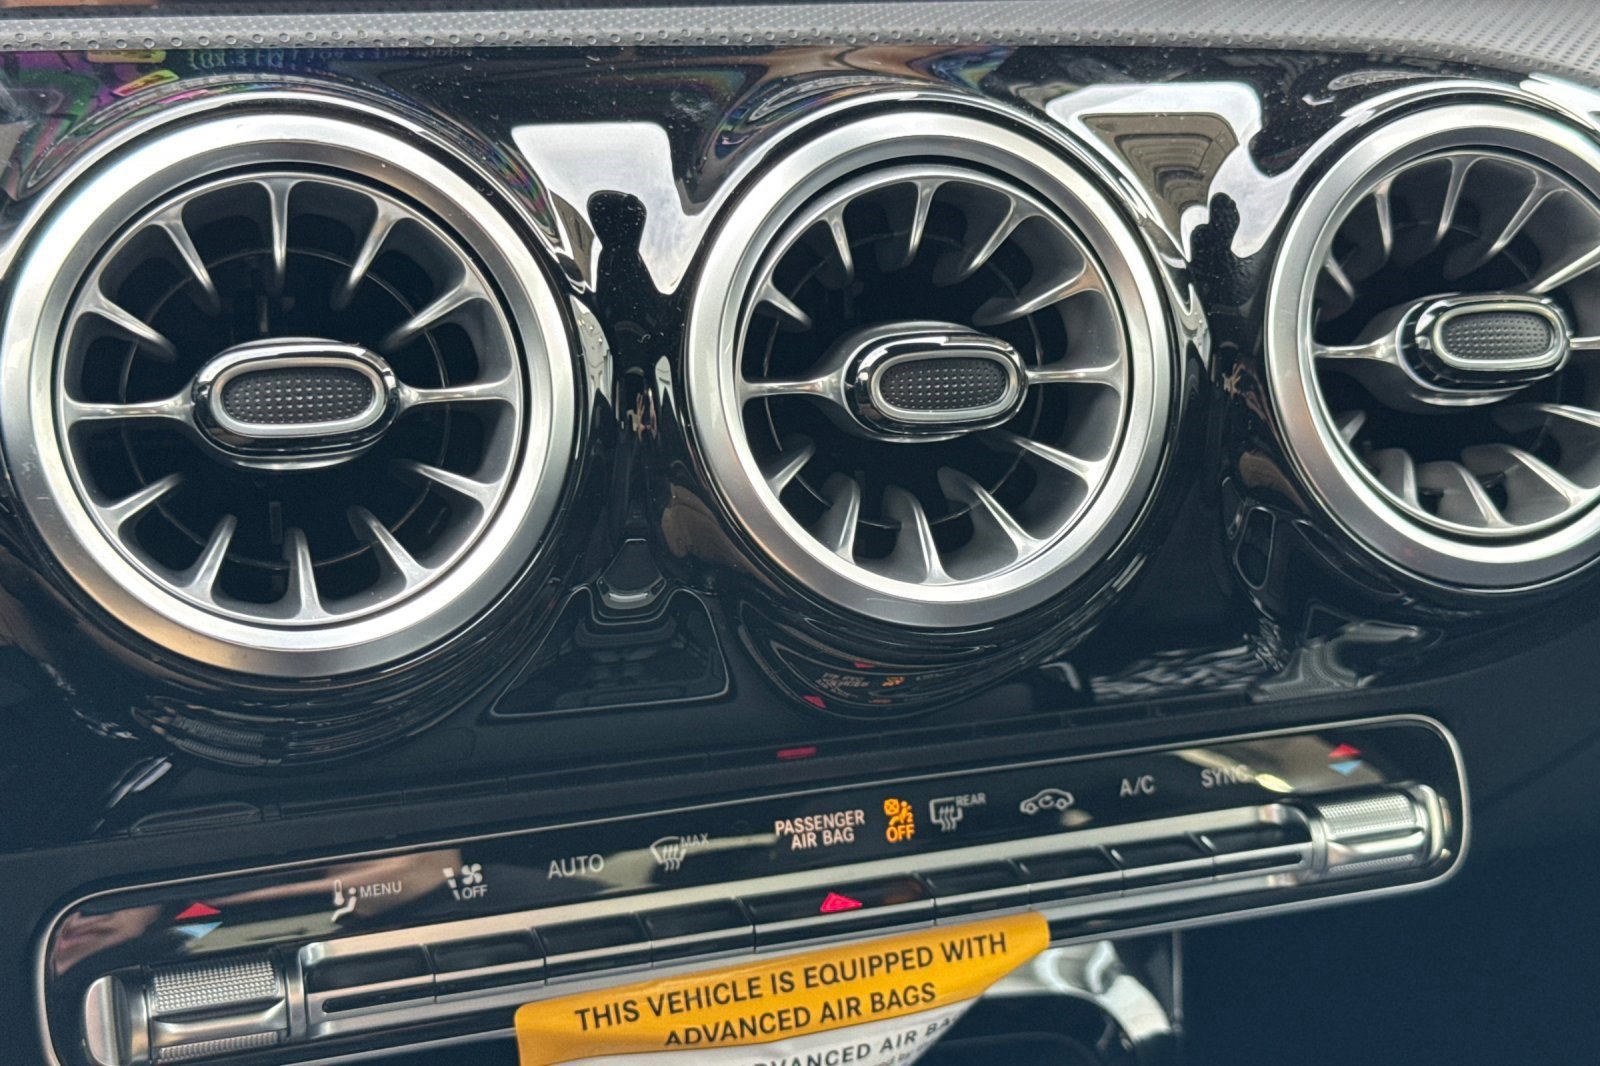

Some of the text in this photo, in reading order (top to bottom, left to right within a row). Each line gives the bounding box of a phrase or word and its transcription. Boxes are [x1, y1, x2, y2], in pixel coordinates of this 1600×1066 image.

[1120, 775, 1155, 797] A/C
[956, 793, 986, 809] REAR
[775, 809, 865, 837] PASSENGER
[886, 823, 916, 843] OFF
[680, 833, 710, 849] MAX
[791, 827, 855, 850] AIR BAG
[547, 854, 605, 880] AUTO
[359, 880, 403, 899] MENU
[462, 884, 488, 900] OFF
[574, 931, 1007, 1031] THIS VEHICLE IS EQUIPPED WITH
[664, 982, 936, 1046] ADVANCED AIR BAGS
[879, 1030, 917, 1054] AIR
